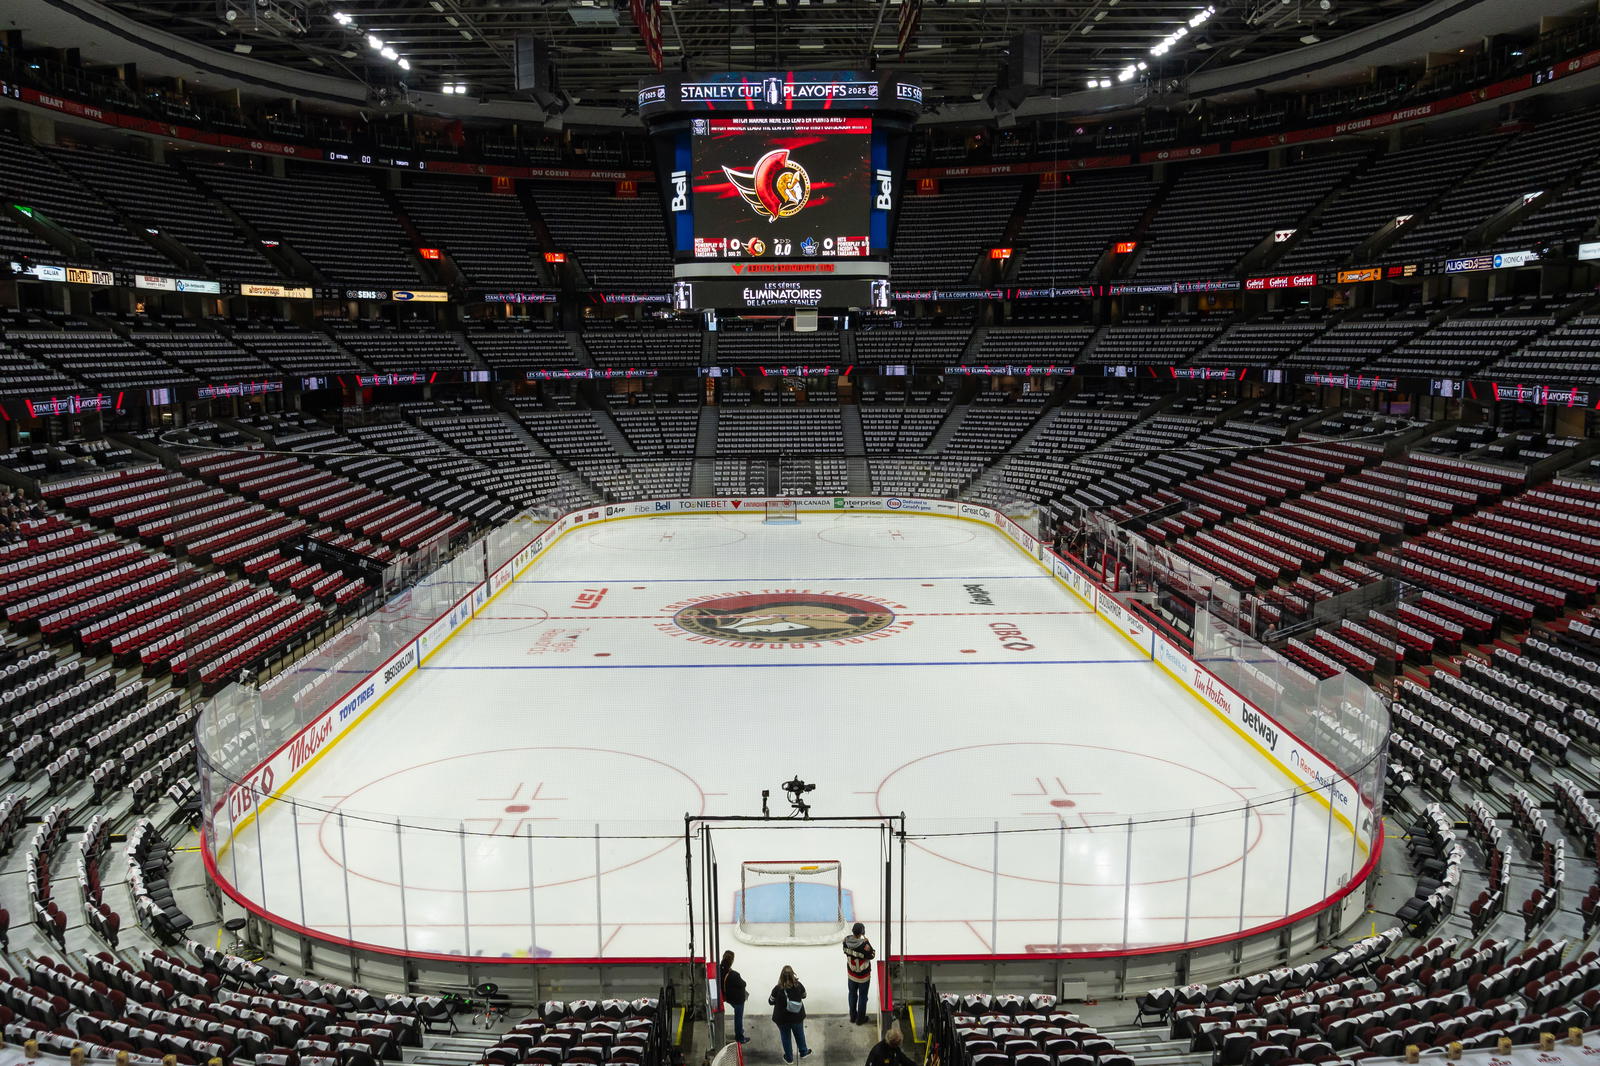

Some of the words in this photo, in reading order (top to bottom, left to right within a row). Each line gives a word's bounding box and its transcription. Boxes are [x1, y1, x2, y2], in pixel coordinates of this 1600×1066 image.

[681, 86, 735, 98] STANLEY
[738, 86, 761, 98] CUP
[784, 85, 846, 97] PLAYOFFS
[897, 86, 912, 97] LES
[40, 95, 64, 108] HEART
[84, 107, 102, 118] HYPE
[1348, 120, 1371, 131] COEUR
[1392, 106, 1432, 120] ARTIFICES
[250, 142, 262, 150] GO
[672, 170, 686, 212] Bell
[876, 170, 892, 210] Bell
[730, 239, 740, 250] 0
[823, 238, 833, 249] 0
[774, 244, 792, 256] 0.0
[1446, 258, 1473, 270] ALIGNED
[778, 281, 800, 289] SÉRIES
[1246, 280, 1264, 288] Gabriel
[1269, 277, 1288, 287] Gabriel
[1293, 274, 1313, 285] Gabriel
[744, 288, 822, 299] ÉLIMINATOIRES
[1454, 382, 1460, 390] 25
[1497, 388, 1521, 398] STANLEY
[1521, 390, 1532, 399] CUP
[1542, 391, 1572, 401] PLAYOFFS
[33, 403, 56, 414] STANLEY
[57, 402, 67, 410] CUP
[75, 399, 100, 408] PLAYOFFS
[655, 501, 671, 511] Bell
[961, 505, 978, 515] Great
[963, 584, 995, 606] betway
[988, 622, 1028, 642] CIBC
[1193, 668, 1205, 690] Tim
[1206, 676, 1231, 714] Hortons
[339, 701, 356, 722] TOYO
[356, 684, 375, 710] TIRES
[1242, 702, 1278, 751] betway
[288, 716, 333, 772] Molson
[230, 776, 261, 823] CIBC
